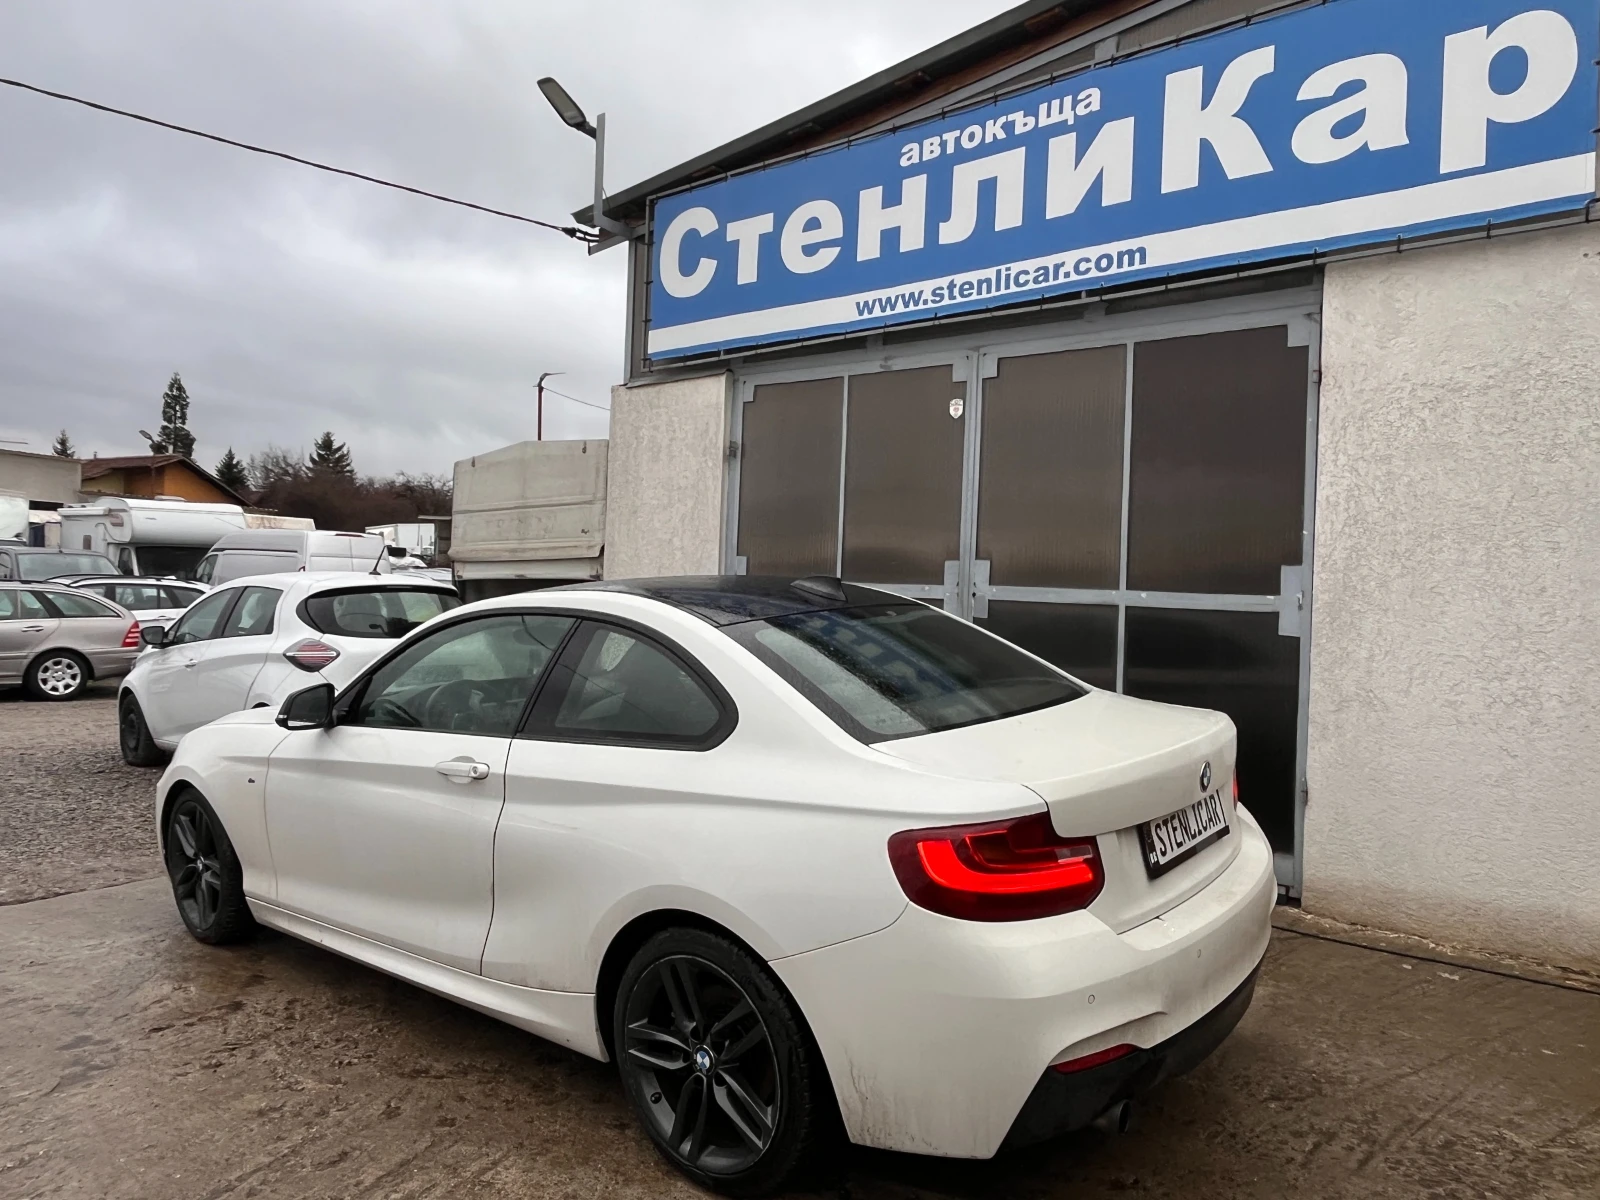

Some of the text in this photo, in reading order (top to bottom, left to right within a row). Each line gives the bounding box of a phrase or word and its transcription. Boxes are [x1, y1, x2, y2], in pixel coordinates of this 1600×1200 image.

[659, 9, 1579, 299] СтенлиКар
[900, 87, 1101, 167] автокъща
[856, 246, 1147, 317] www.stenlicar.com
[1154, 793, 1222, 857] STENLICAR
